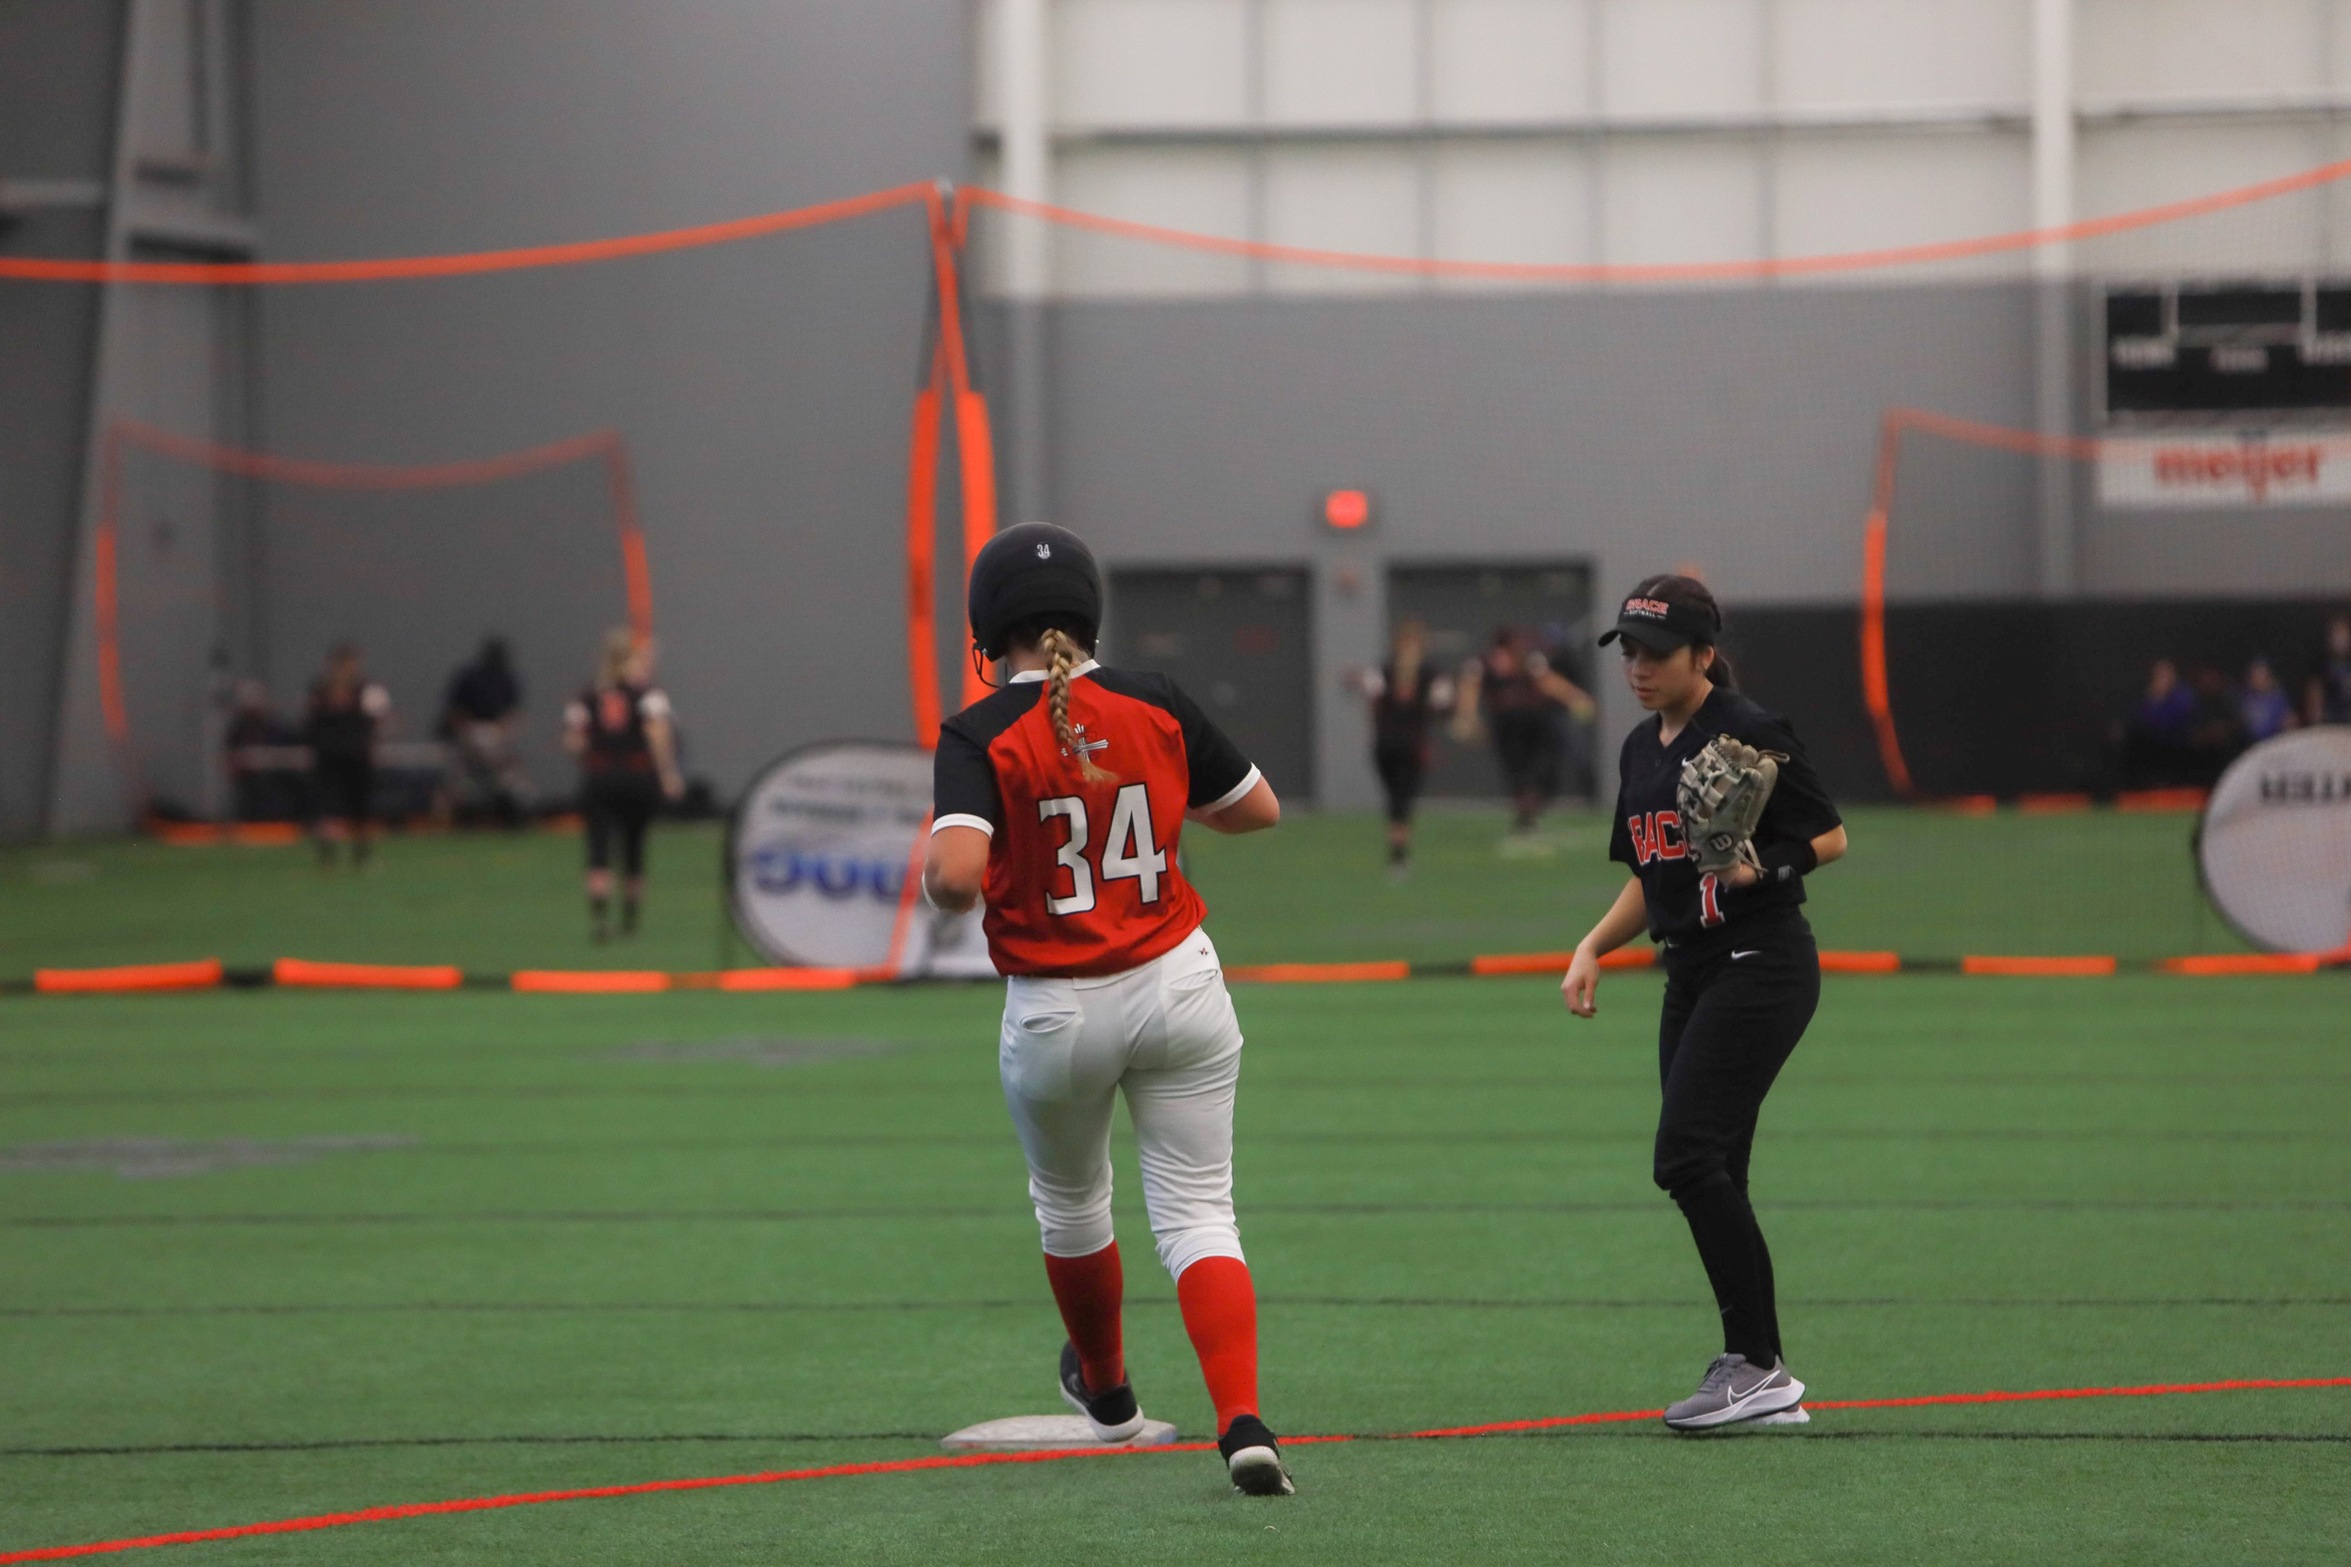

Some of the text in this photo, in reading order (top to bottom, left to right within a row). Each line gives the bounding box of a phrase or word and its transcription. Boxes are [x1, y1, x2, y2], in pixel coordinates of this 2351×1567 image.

[1036, 543, 1050, 558] 34
[1038, 783, 1168, 916] 34
[1628, 810, 1697, 866] RAC
[1699, 871, 1726, 929] 1
